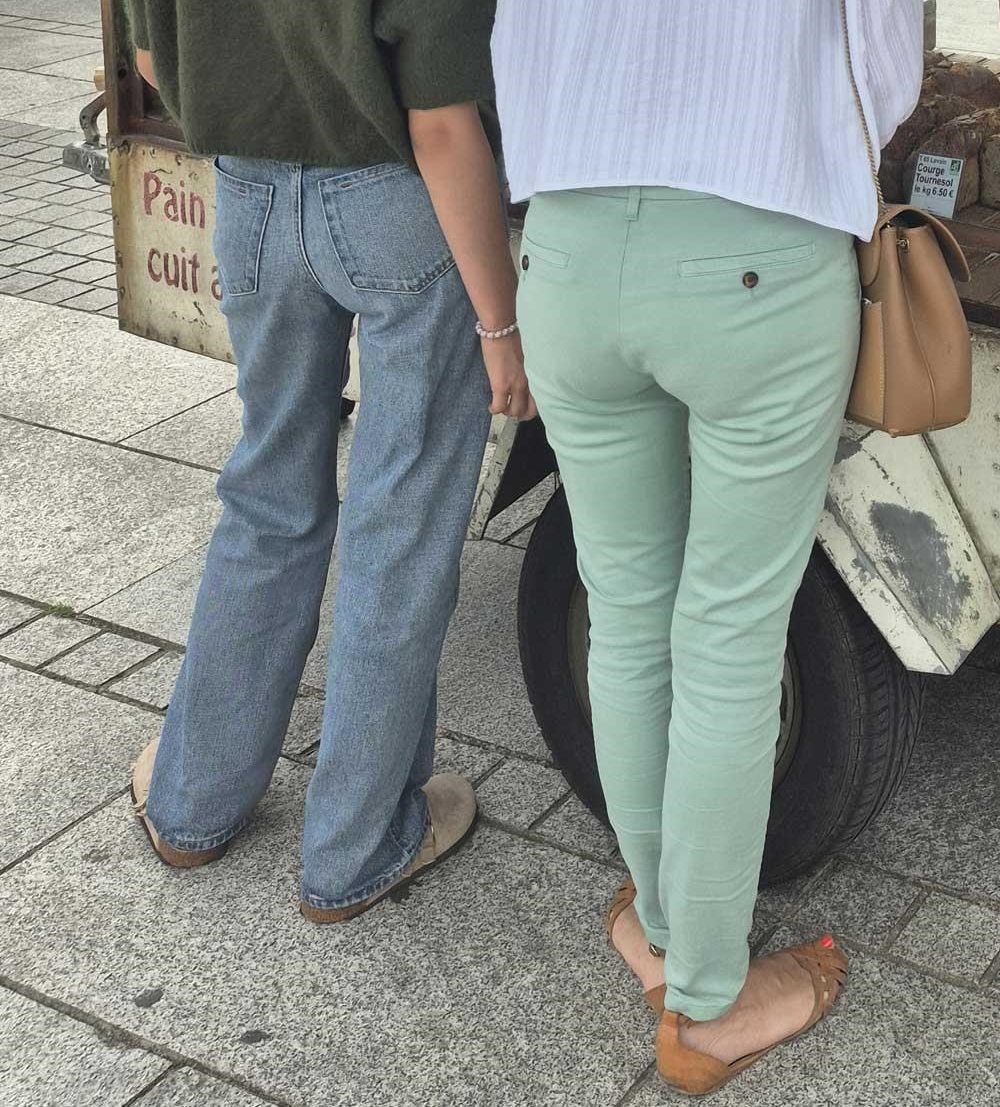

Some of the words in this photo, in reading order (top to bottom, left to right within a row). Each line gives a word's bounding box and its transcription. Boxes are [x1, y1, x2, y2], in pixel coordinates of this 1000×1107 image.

[918, 163, 945, 176] Courge
[916, 173, 954, 187] Tournesol
[922, 186, 931, 196] kg
[932, 187, 948, 198] 6.50
[949, 190, 954, 198] €
[144, 172, 206, 229] Pain
[148, 246, 200, 294] cuit
